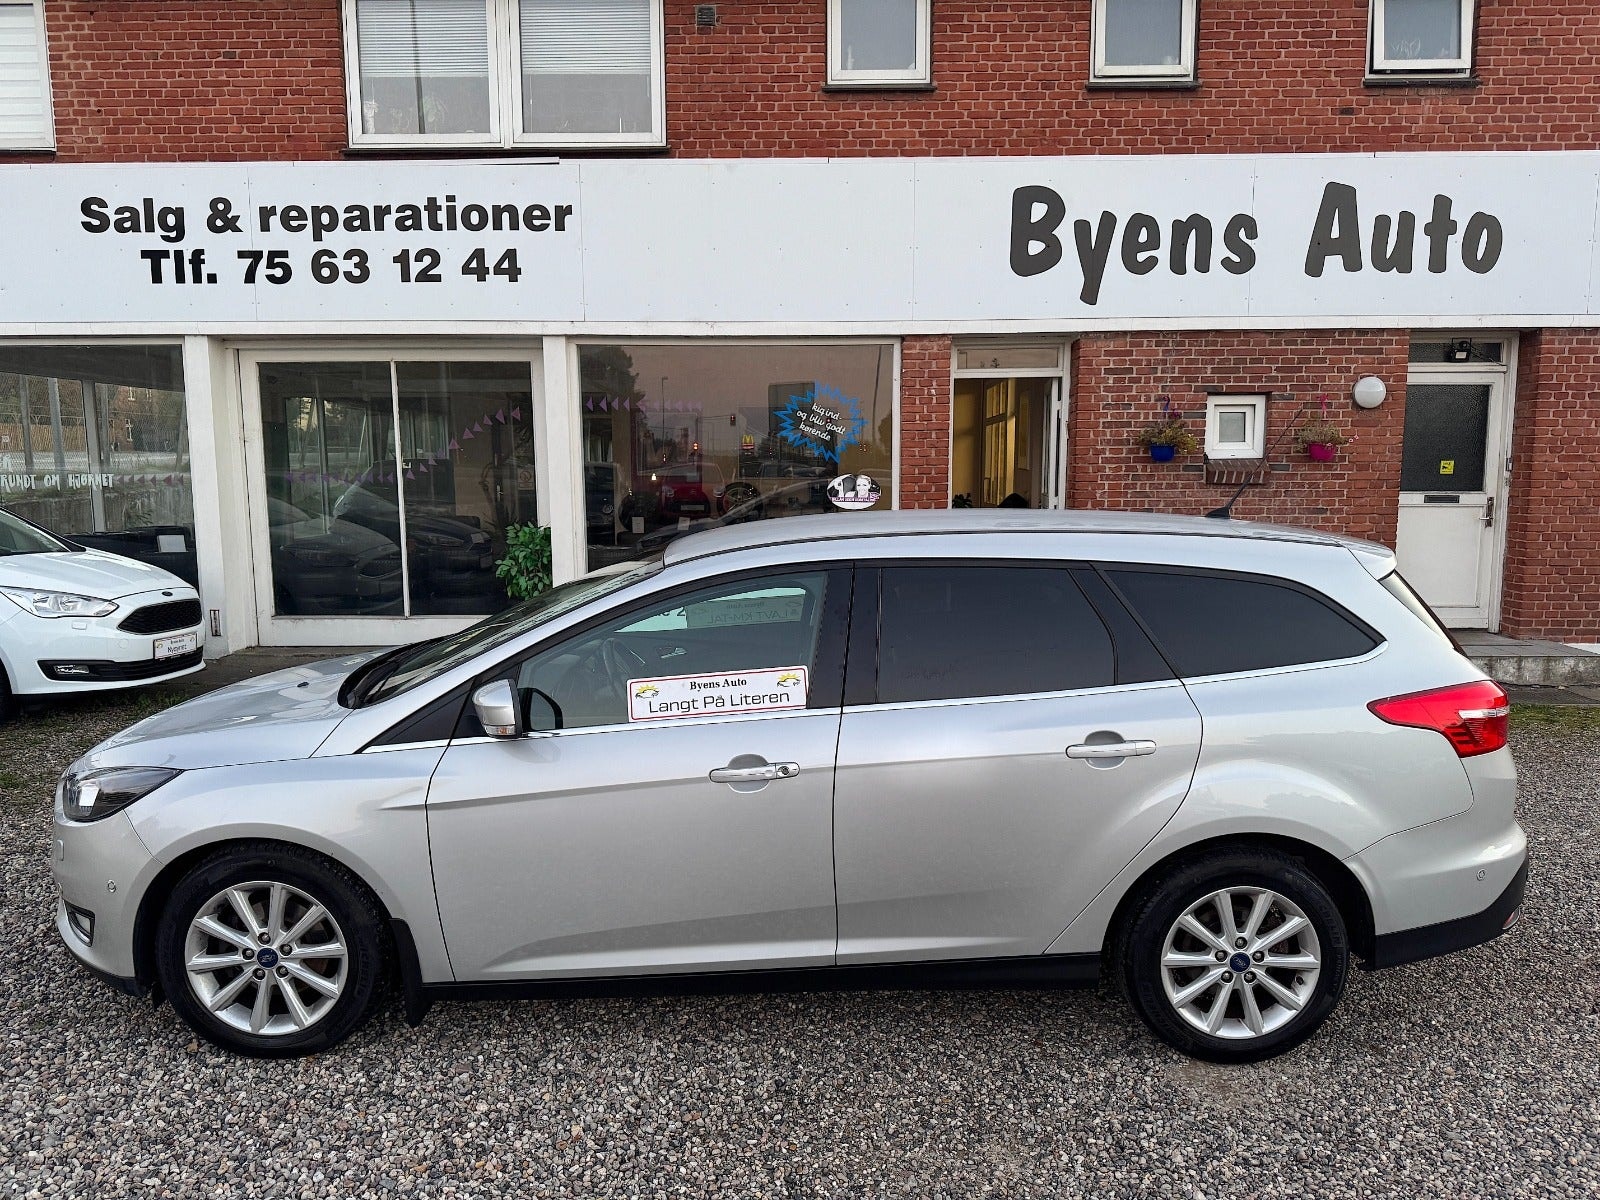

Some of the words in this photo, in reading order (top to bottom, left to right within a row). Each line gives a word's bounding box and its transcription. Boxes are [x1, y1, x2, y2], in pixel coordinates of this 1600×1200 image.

[81, 197, 185, 243] Salg
[207, 197, 243, 233] &
[259, 195, 572, 241] reparationer
[1010, 186, 1258, 305] Byens
[1305, 182, 1502, 277] Auto
[141, 249, 217, 284] Tlf.
[237, 250, 292, 284] 75
[311, 249, 370, 284] 63
[393, 248, 441, 282] 12
[462, 248, 521, 282] 44
[796, 410, 808, 420] og
[825, 423, 846, 435] godt
[799, 421, 831, 442] kørende
[43, 474, 60, 491] OM
[690, 679, 720, 692] Byens
[722, 678, 747, 688] Auto
[649, 698, 699, 714] Langt
[703, 695, 725, 708] På
[730, 692, 790, 707] Literen
